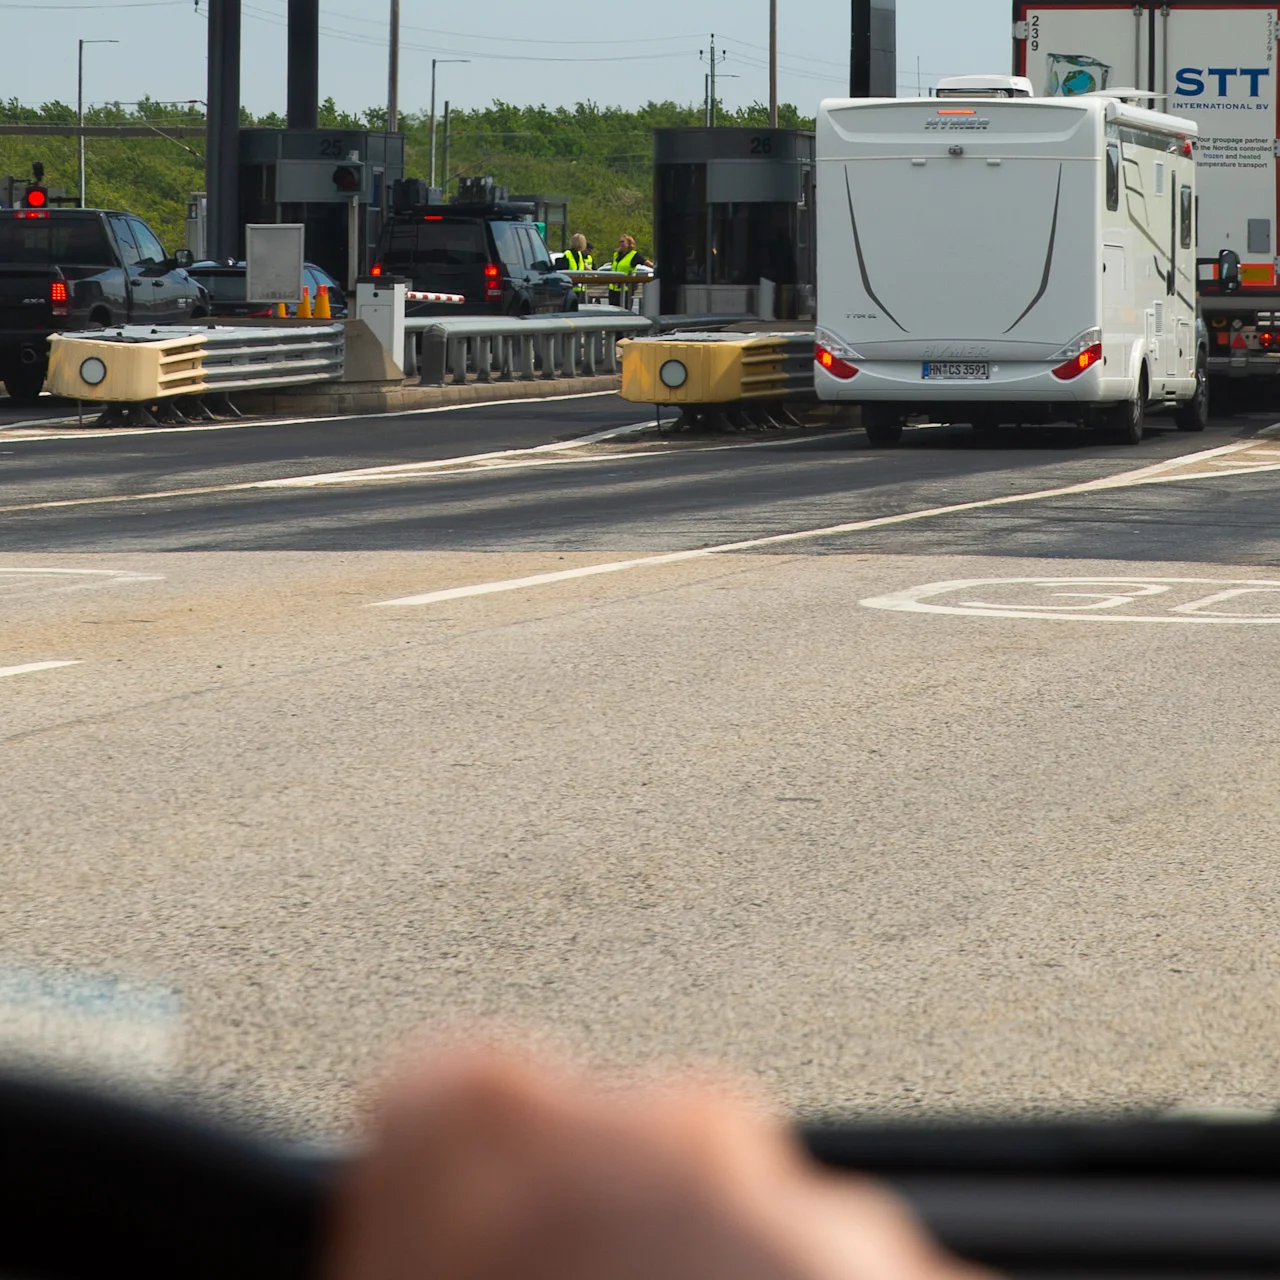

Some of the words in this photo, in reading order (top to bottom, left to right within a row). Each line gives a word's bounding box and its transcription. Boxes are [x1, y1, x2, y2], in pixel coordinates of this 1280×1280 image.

[1174, 66, 1270, 97] STT
[1173, 102, 1253, 110] INTERNATIONAL
[1256, 102, 1269, 110] BV
[924, 117, 990, 130] HYMER
[320, 138, 342, 157] 25
[750, 136, 772, 155] 26
[1237, 161, 1268, 169] transport
[920, 345, 989, 358] HYMER
[929, 364, 942, 375] HN
[948, 364, 961, 375] CS
[963, 364, 987, 376] 3591
